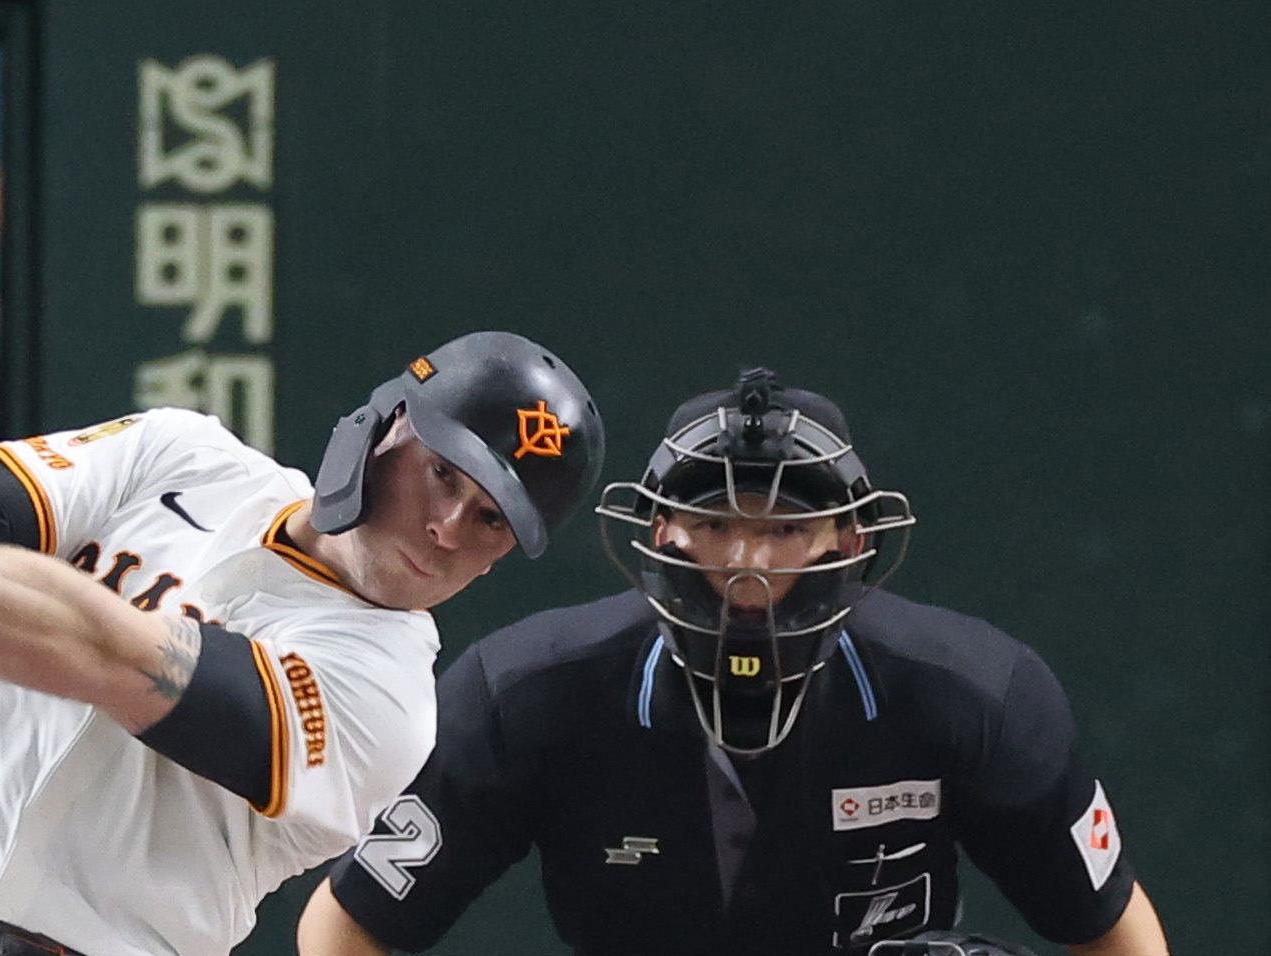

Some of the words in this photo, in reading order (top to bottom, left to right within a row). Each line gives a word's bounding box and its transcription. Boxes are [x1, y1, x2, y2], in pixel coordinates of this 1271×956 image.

[279, 652, 326, 769] YOMIURI
[353, 794, 443, 901] 2
[867, 791, 936, 816] 日本生命
